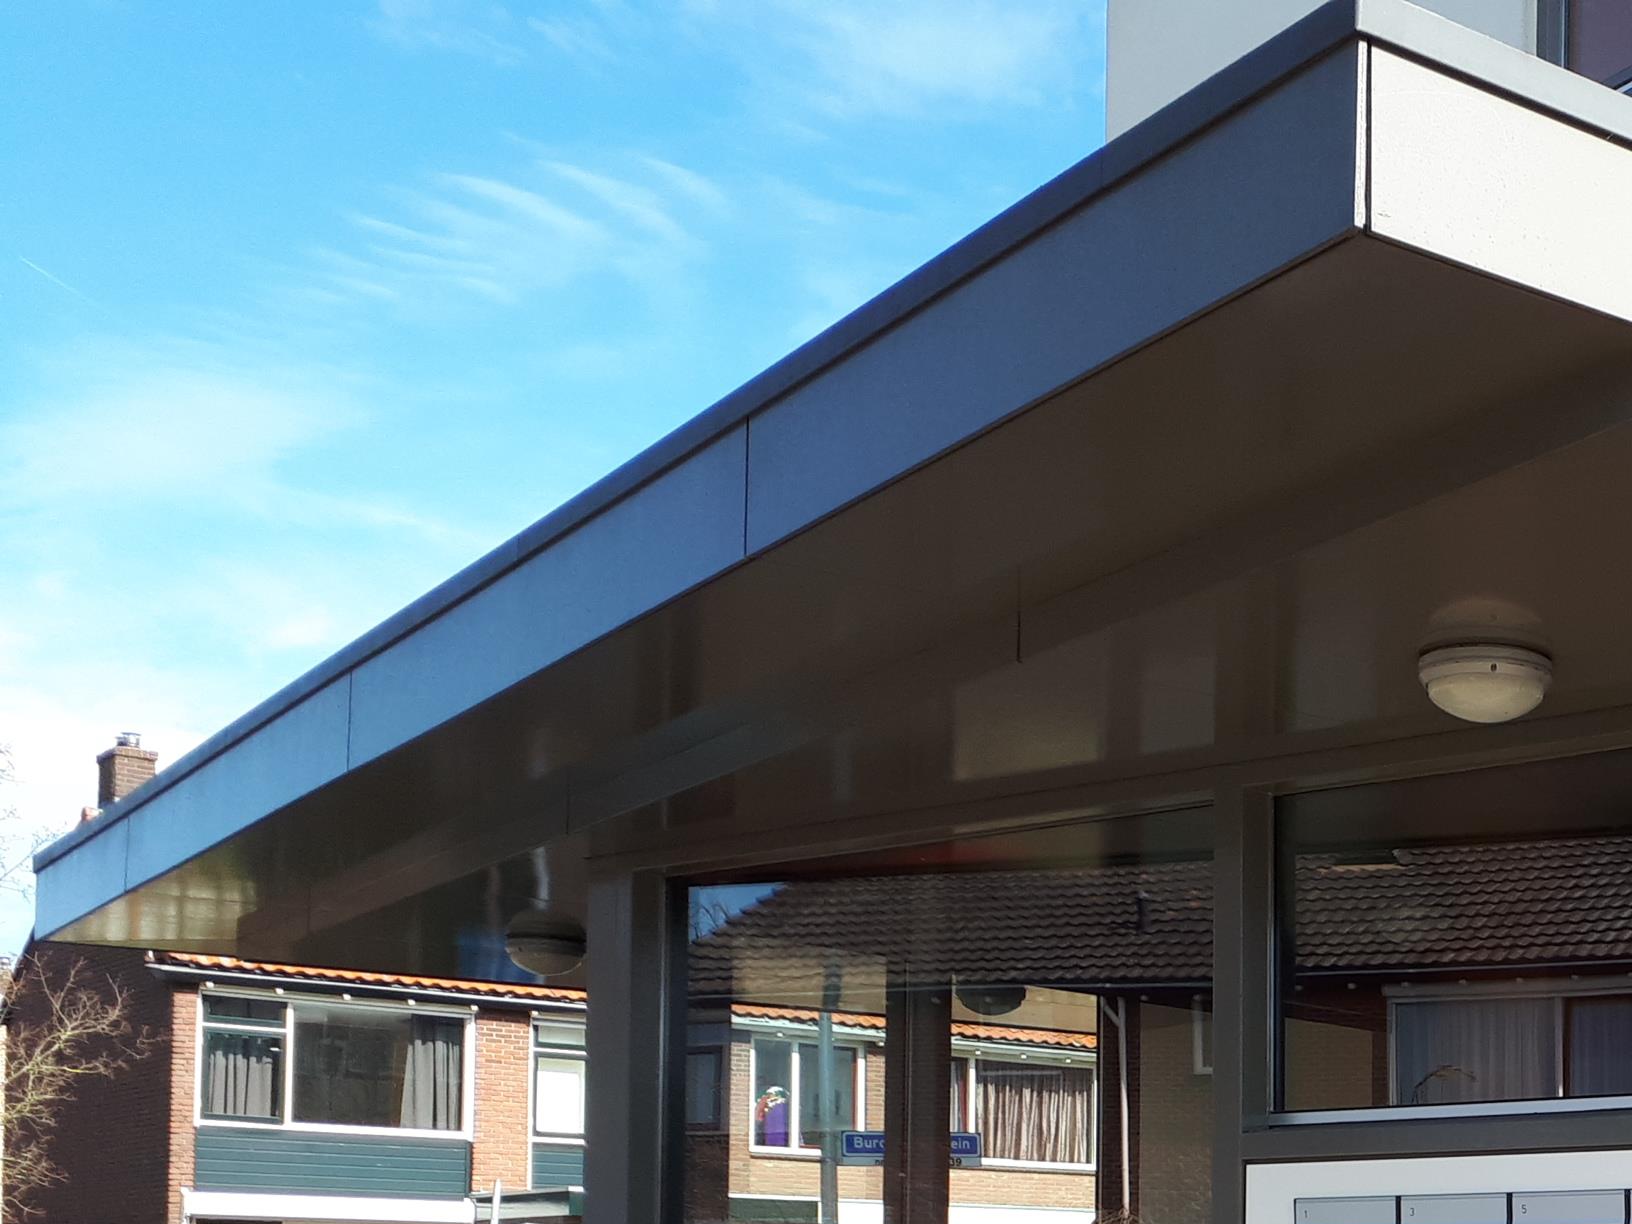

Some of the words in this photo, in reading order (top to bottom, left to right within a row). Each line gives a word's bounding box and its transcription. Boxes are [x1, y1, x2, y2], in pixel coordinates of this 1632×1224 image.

[951, 1137, 970, 1149] ein
[1409, 1207, 1415, 1217] 3
[1521, 1203, 1528, 1215] 5
